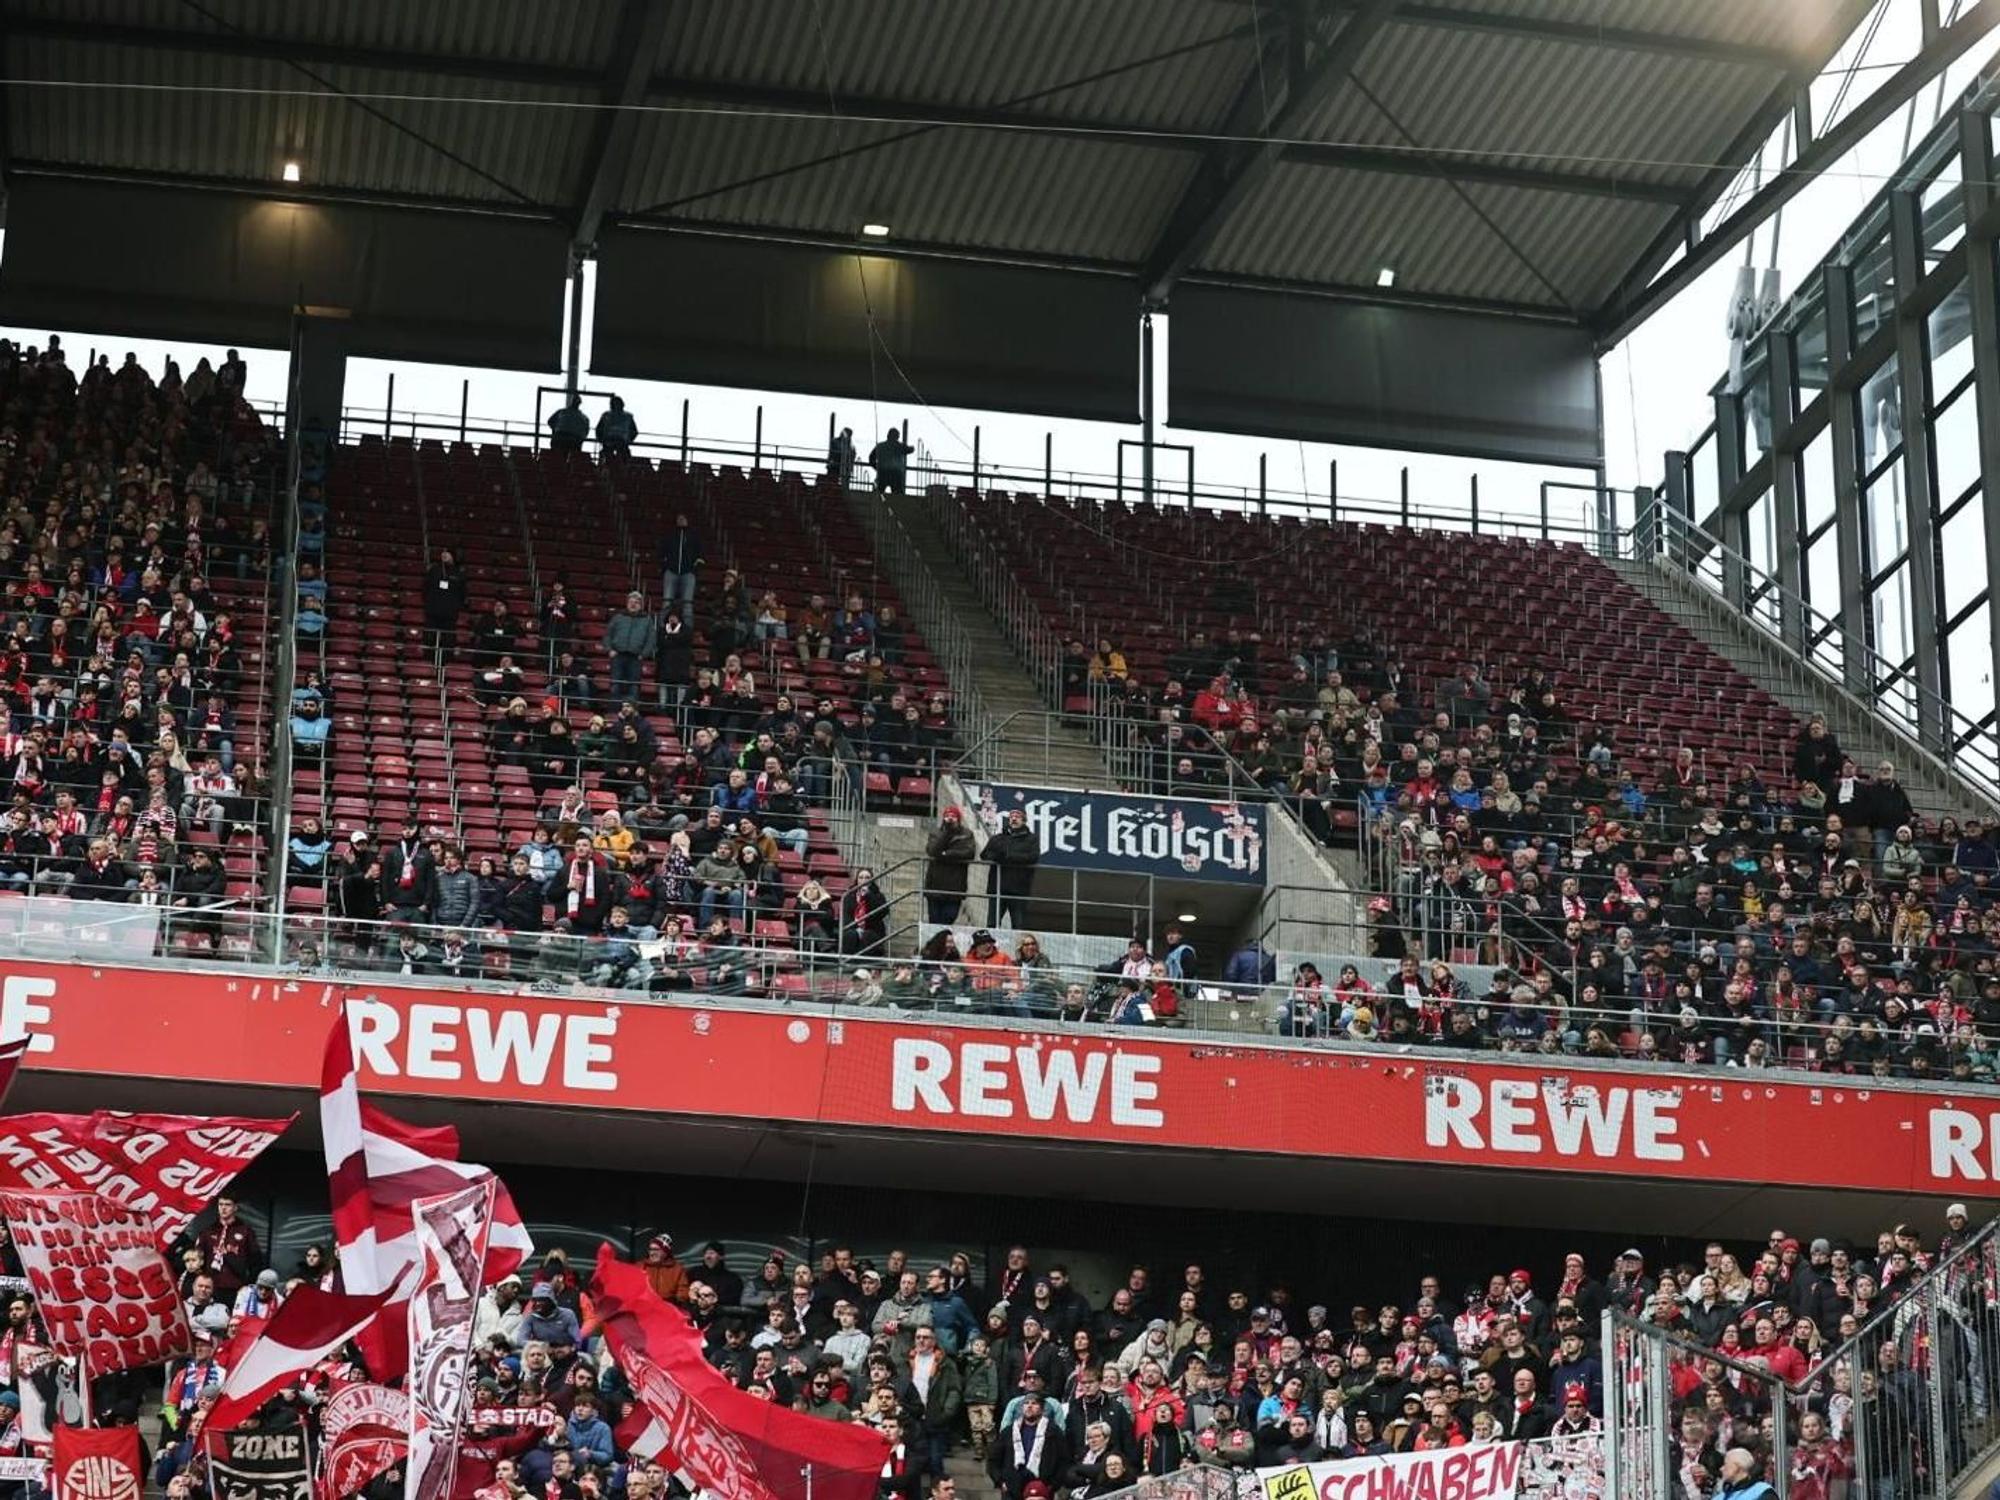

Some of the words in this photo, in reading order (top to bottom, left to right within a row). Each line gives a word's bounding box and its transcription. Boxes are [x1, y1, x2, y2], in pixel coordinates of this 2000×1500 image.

[341, 998, 617, 1091] REWE
[892, 1038, 1164, 1128] REWE
[1425, 1075, 1684, 1161] REWE
[49, 1247, 112, 1268] MEIN
[65, 1456, 135, 1498] EINS
[232, 1435, 299, 1460] ZONE
[1320, 1441, 1522, 1500] SCHWABEN
